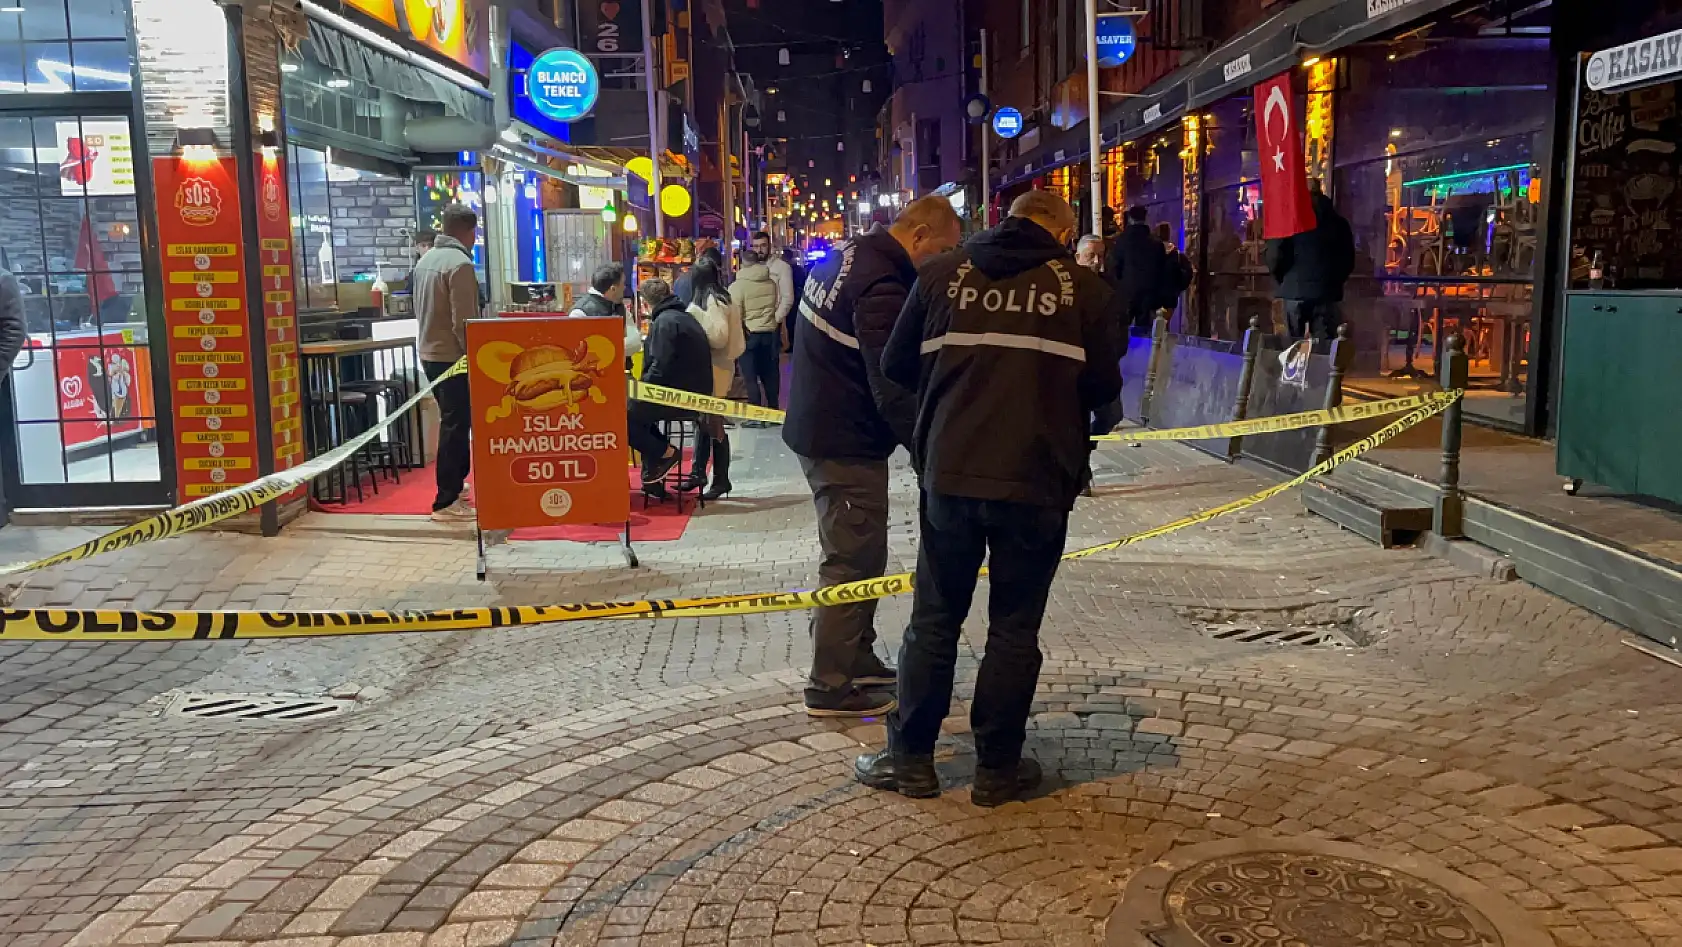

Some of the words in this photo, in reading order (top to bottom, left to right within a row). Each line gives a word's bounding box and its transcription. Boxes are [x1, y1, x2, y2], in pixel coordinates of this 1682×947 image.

[1096, 35, 1132, 45] ASAVER
[1608, 35, 1682, 81] KASAV
[537, 71, 587, 84] BLANCO
[543, 85, 582, 98] TEKEL
[185, 182, 210, 207] SOS
[959, 283, 1058, 316] POLİS
[523, 413, 584, 433] ISLAK
[489, 431, 617, 455] HAMBURGER
[527, 461, 555, 480] 50
[559, 460, 588, 479] TL
[174, 495, 241, 532] GİRİLMEZ
